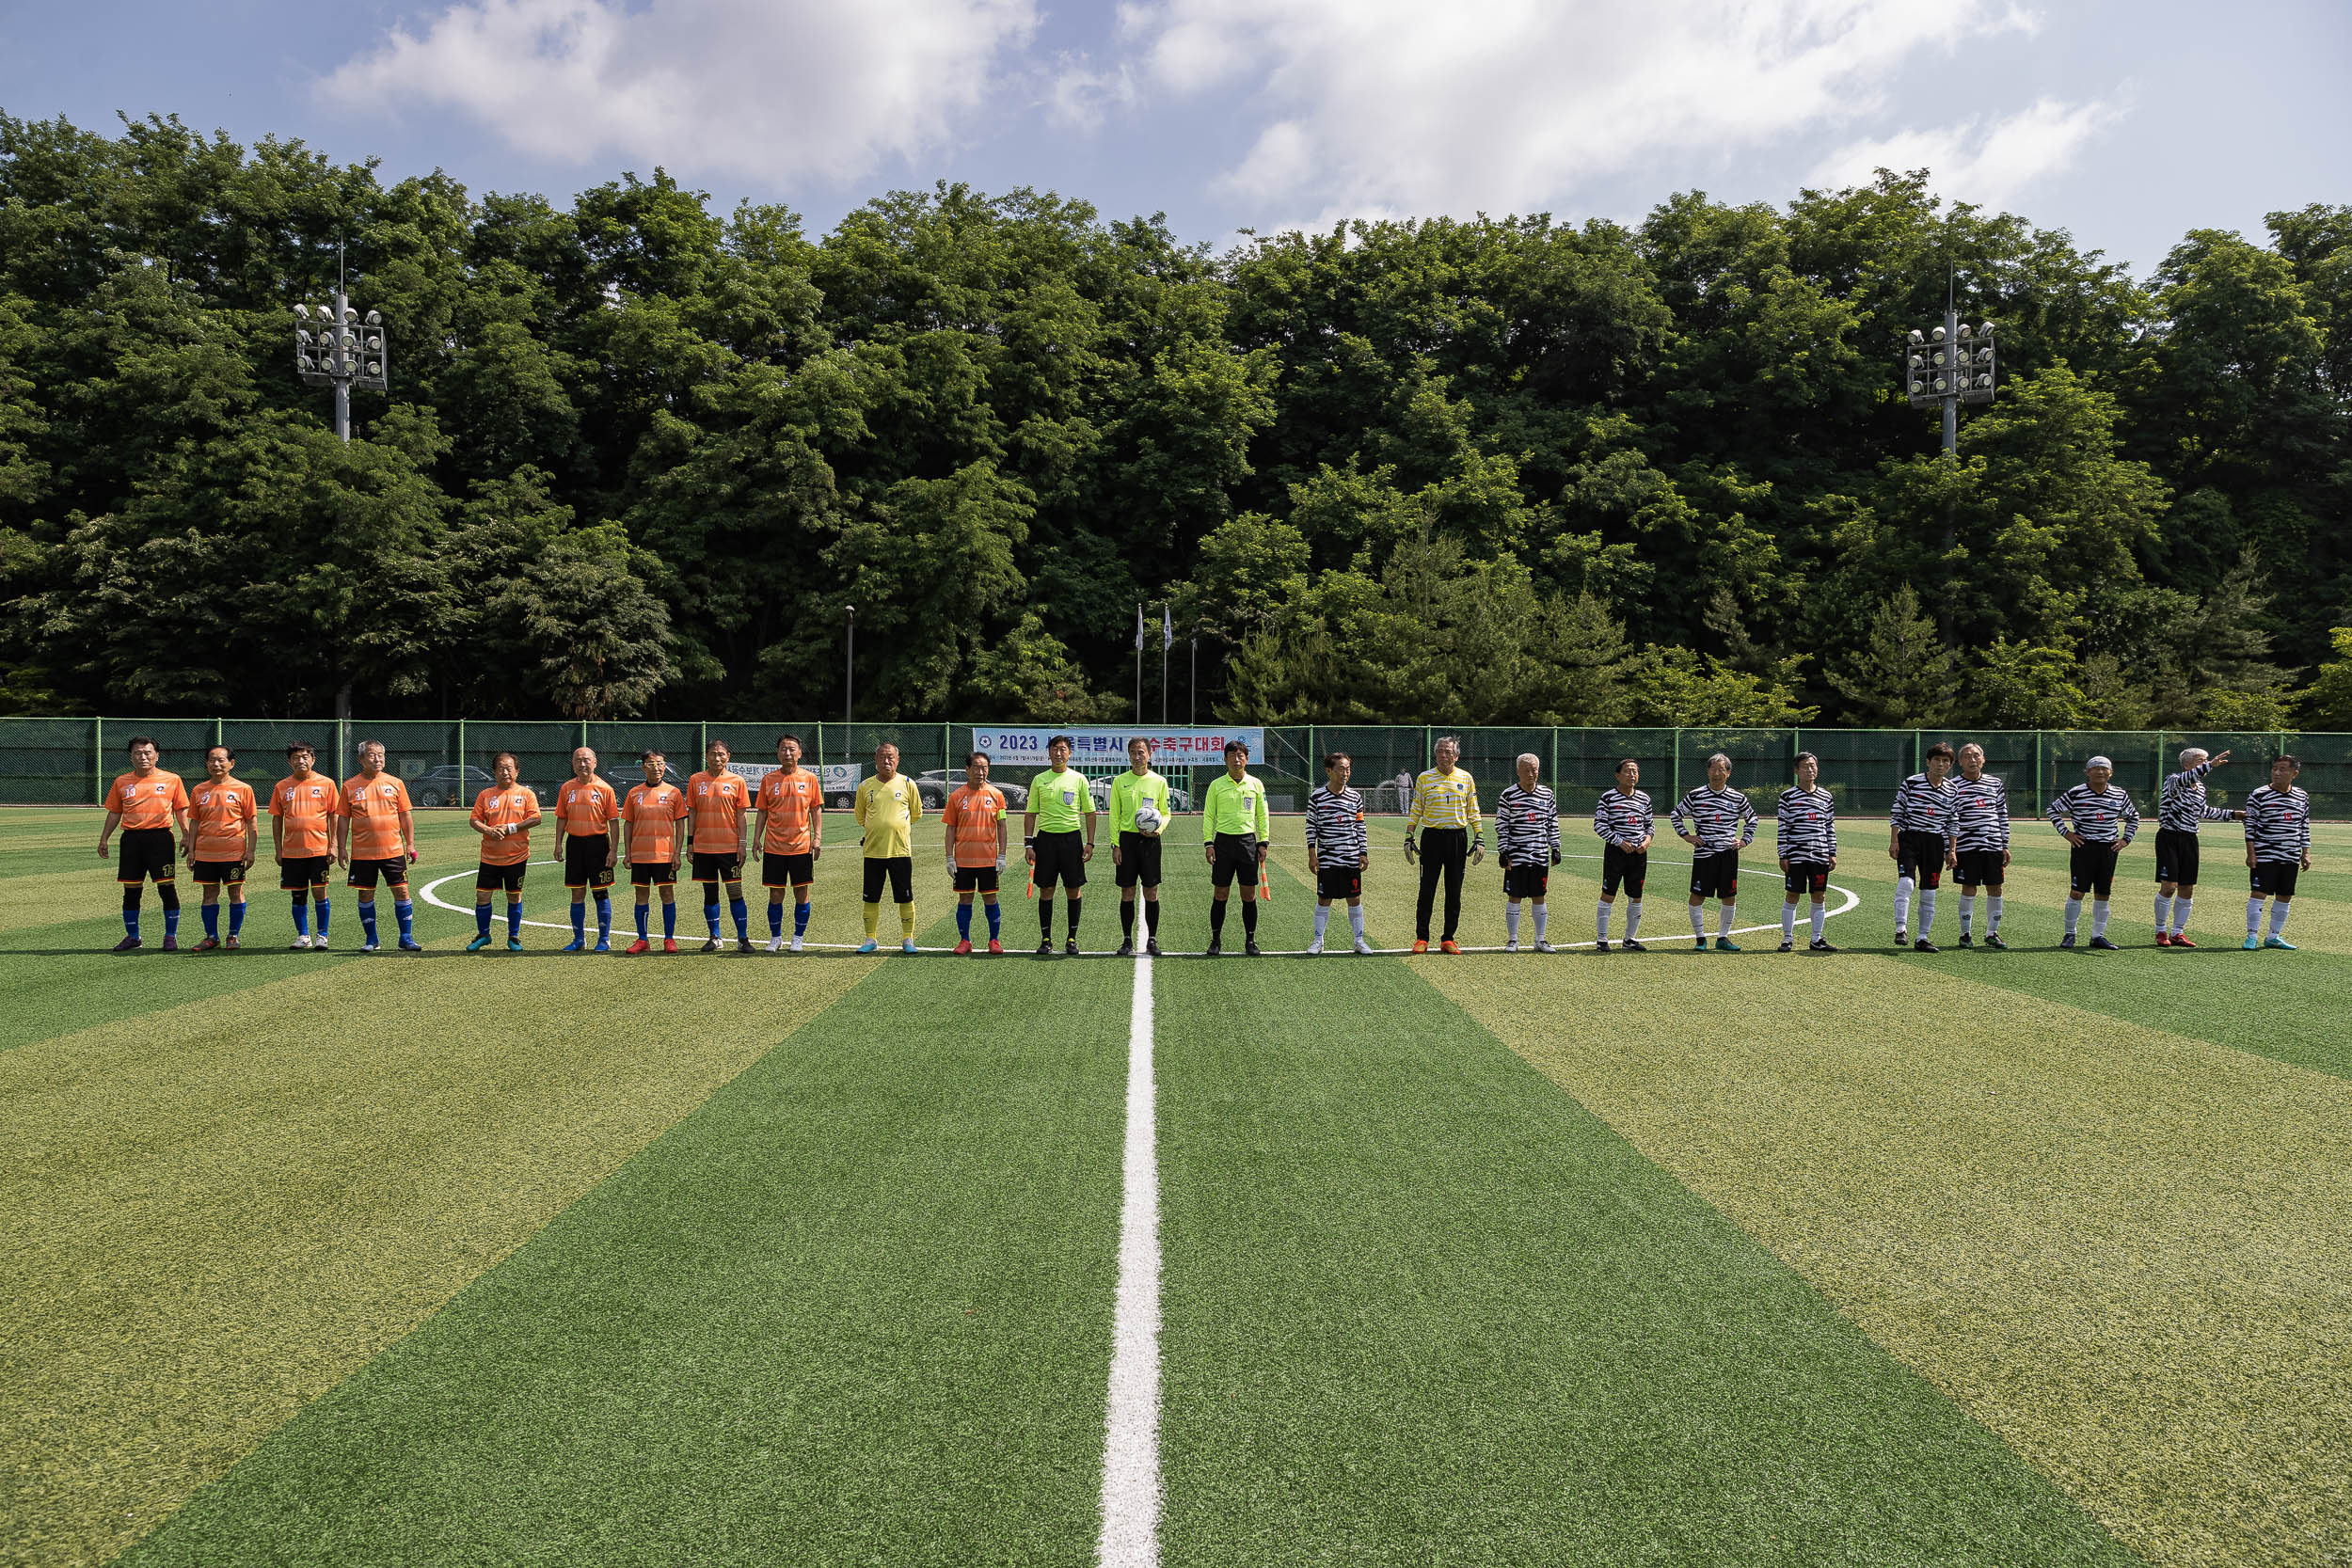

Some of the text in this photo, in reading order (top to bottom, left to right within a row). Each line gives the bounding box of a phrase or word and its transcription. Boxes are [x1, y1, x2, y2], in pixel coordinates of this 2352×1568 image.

[999, 735, 1038, 750] 2023
[1150, 736, 1225, 752] 수축구대회
[125, 787, 136, 798] 13
[489, 800, 499, 810] 99
[1446, 796, 1450, 804] 1
